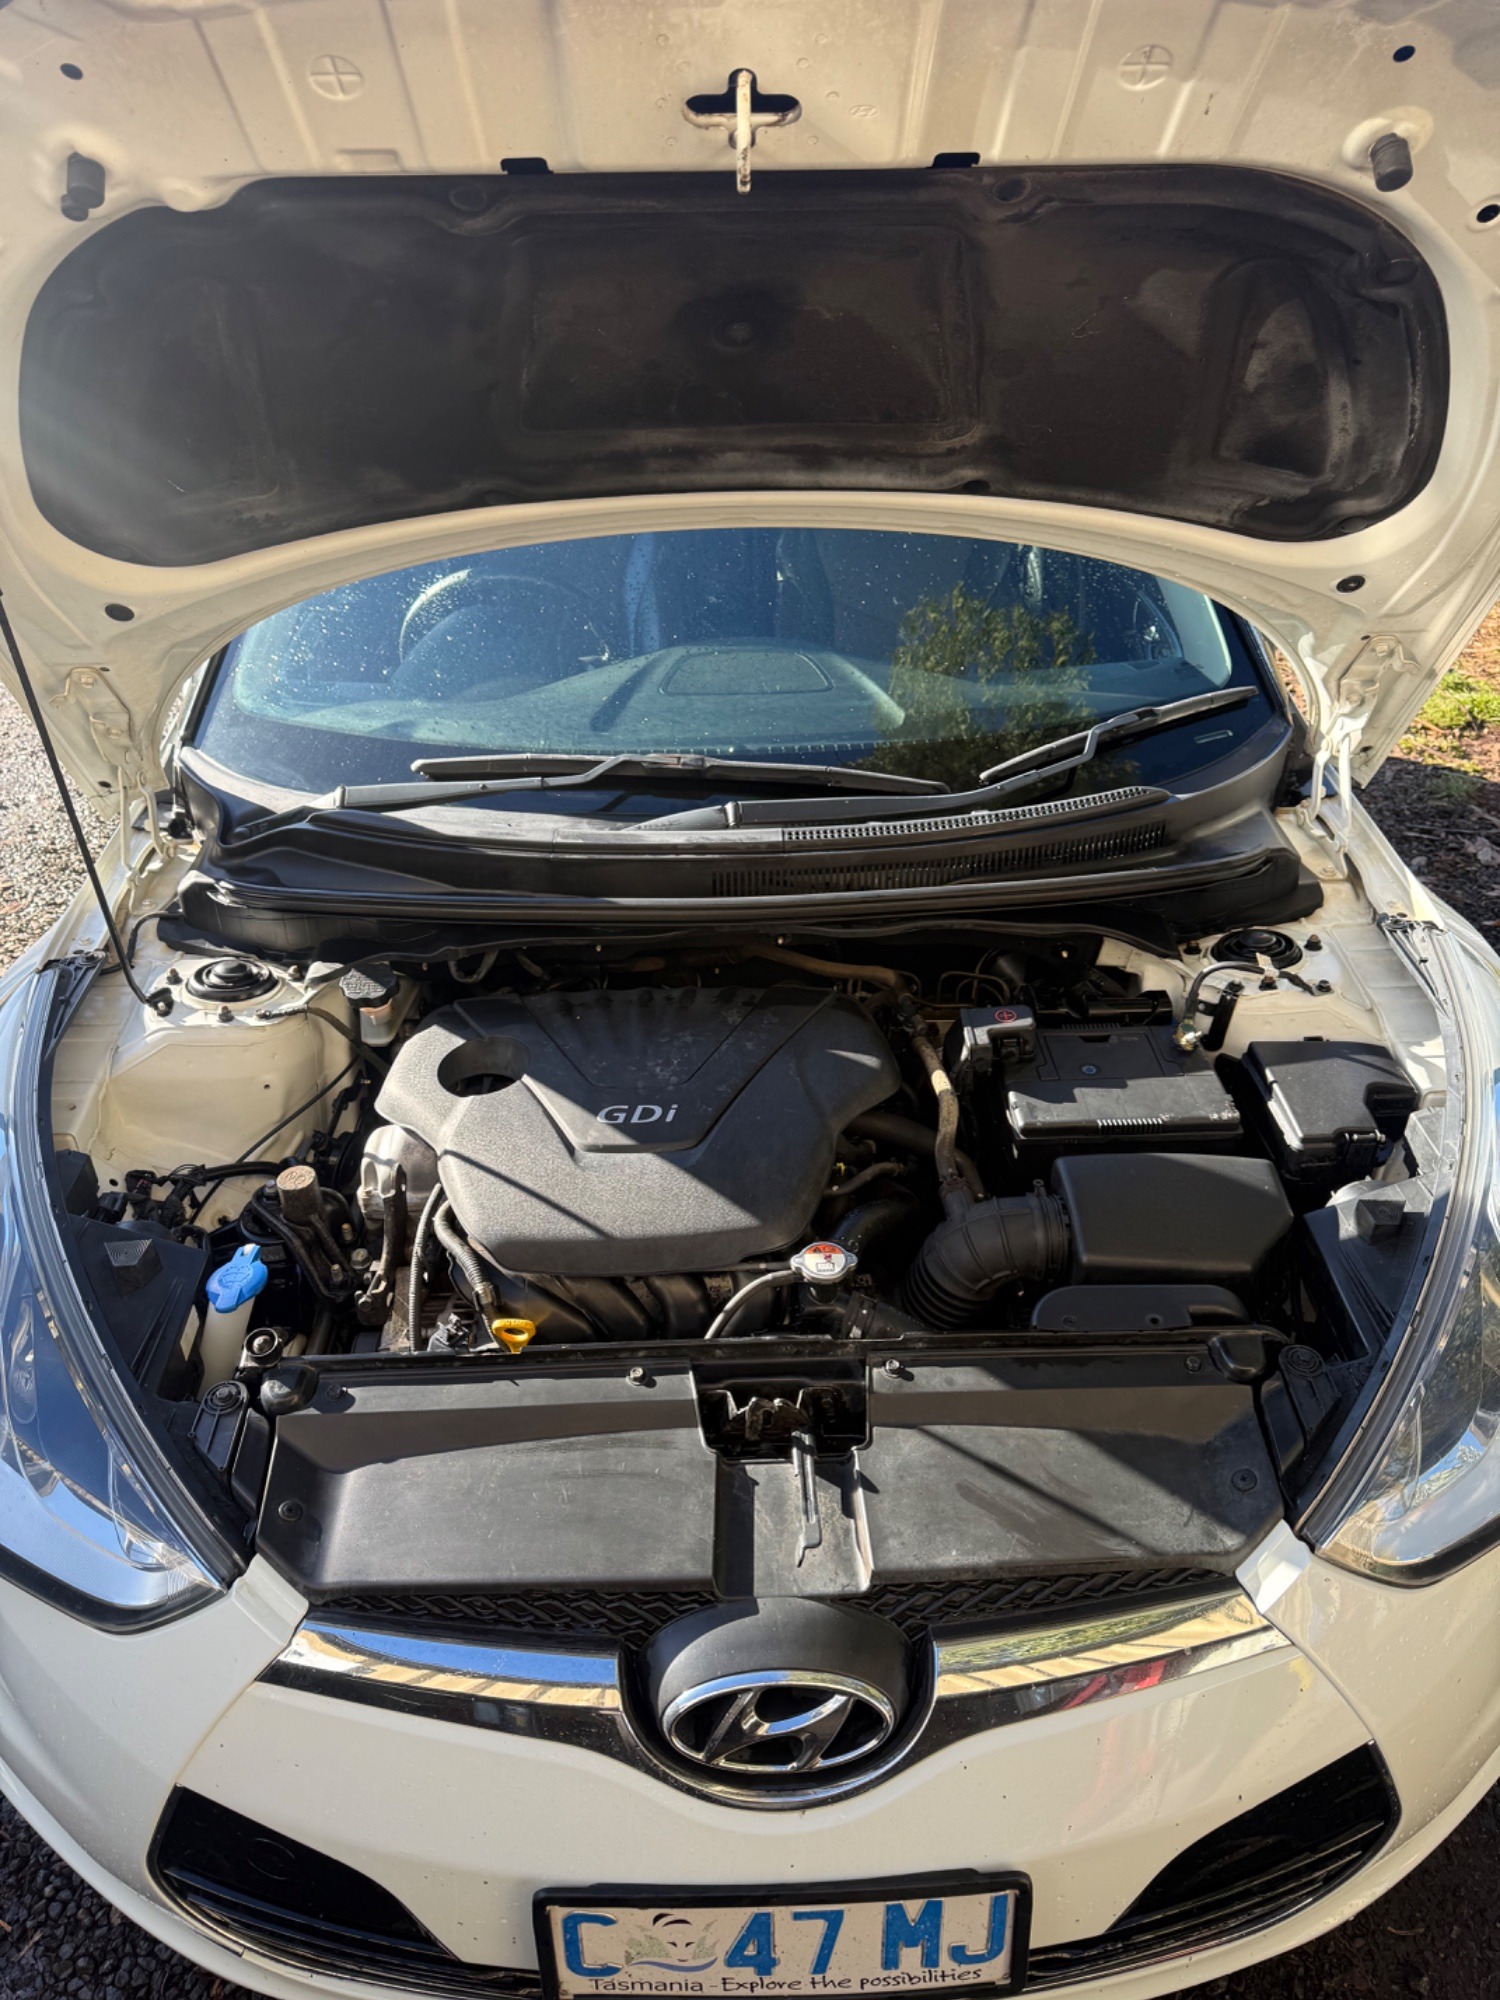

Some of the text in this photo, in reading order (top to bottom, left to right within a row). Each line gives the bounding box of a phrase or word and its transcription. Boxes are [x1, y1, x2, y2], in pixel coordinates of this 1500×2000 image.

[597, 1104, 678, 1124] GDi
[881, 1893, 1009, 1970] MJ
[589, 1978, 703, 1992] Tasmania
[721, 1977, 802, 1993] Explore
[811, 1975, 852, 1990] the
[860, 1968, 982, 1991] possibilities
